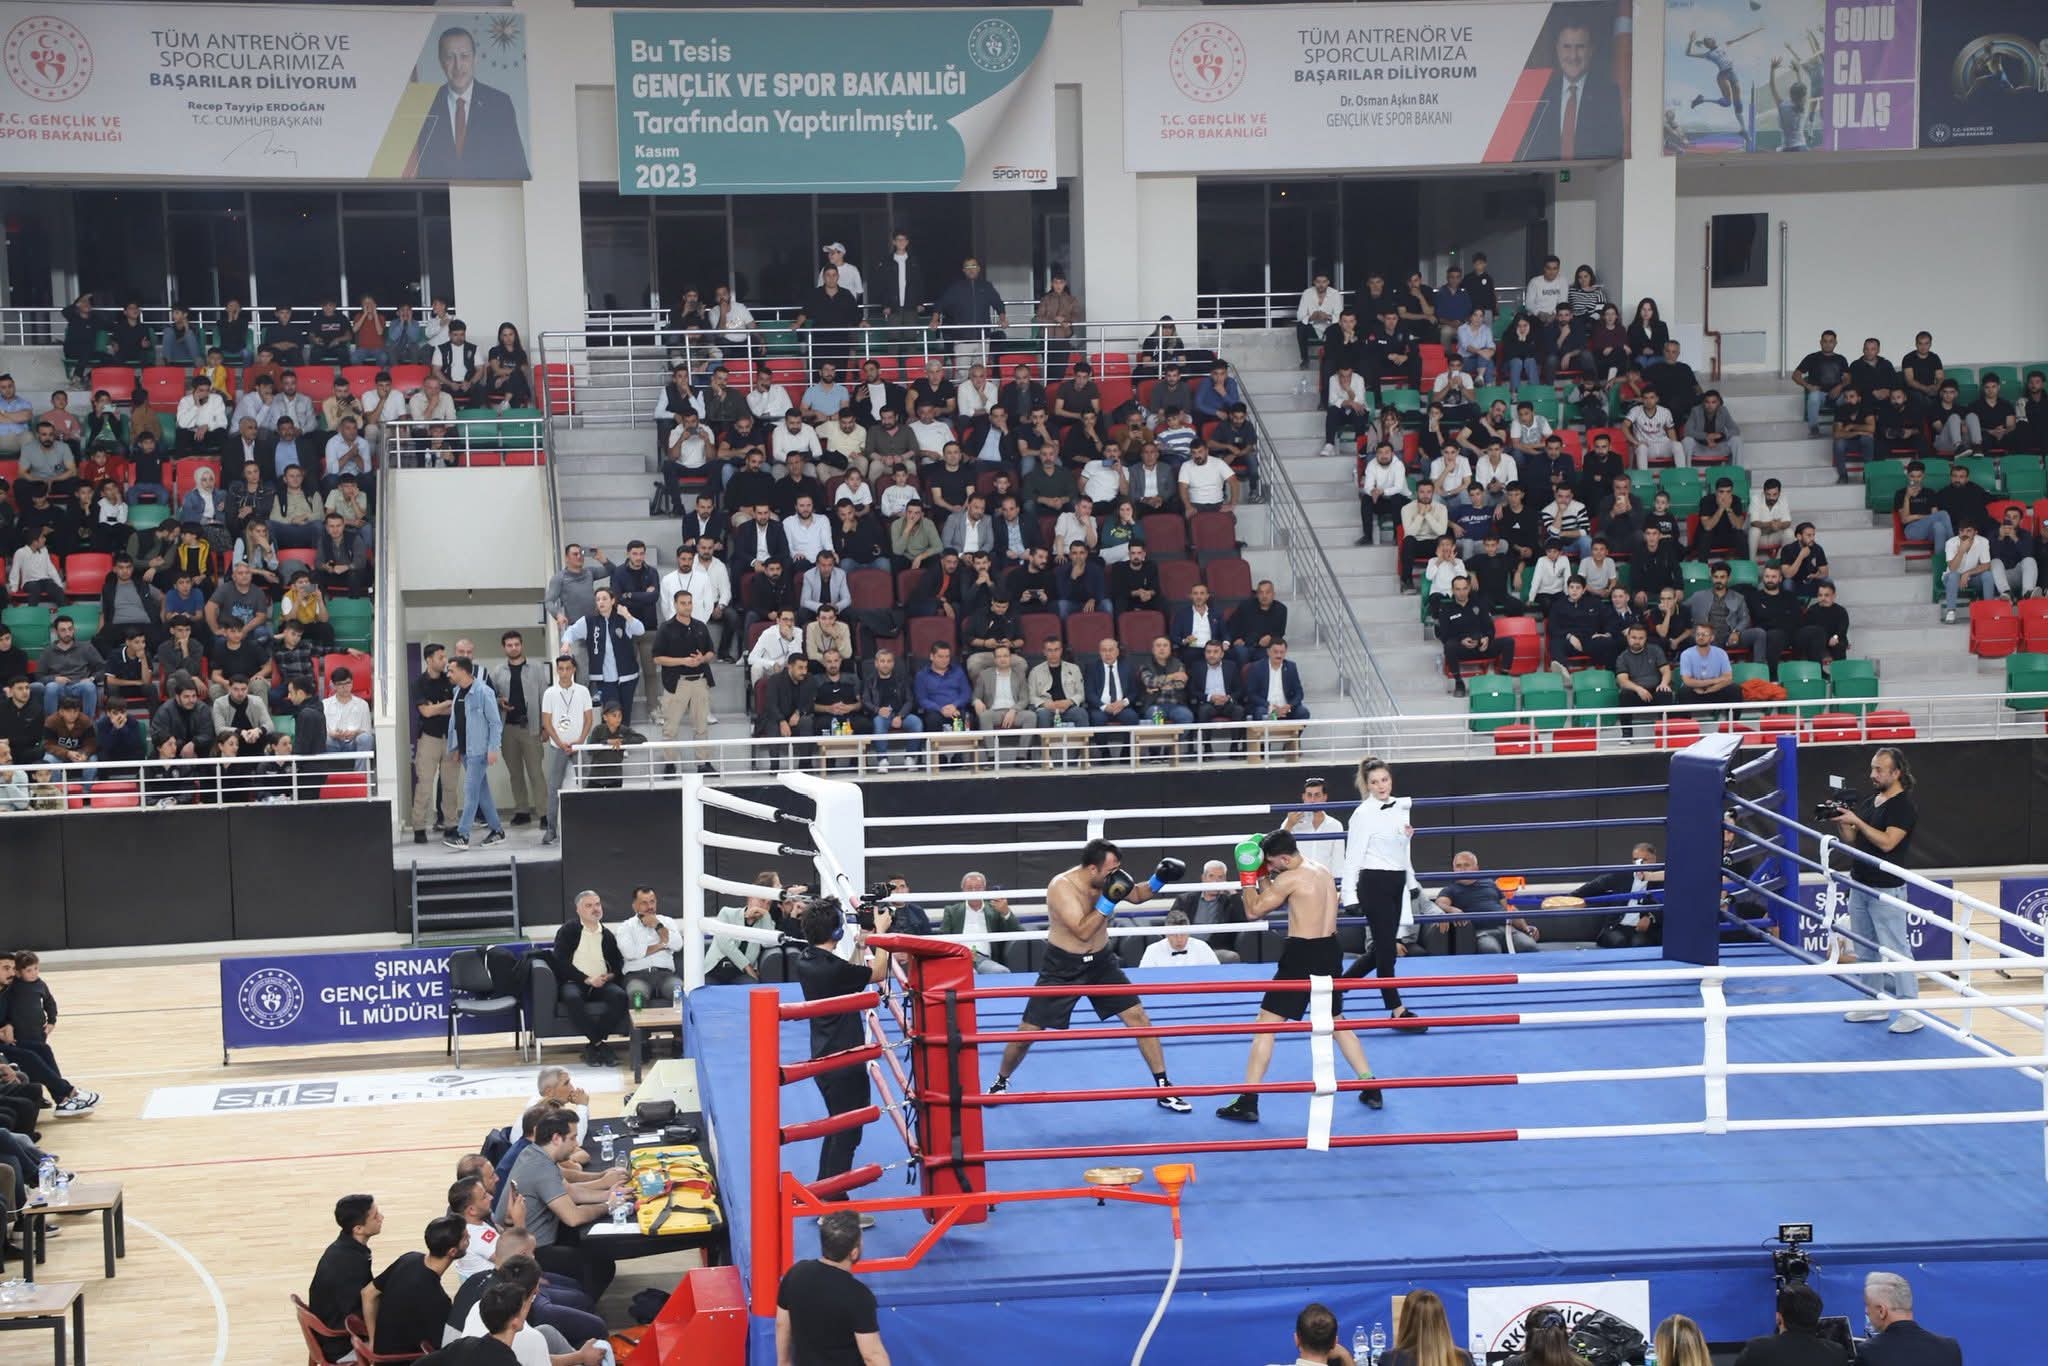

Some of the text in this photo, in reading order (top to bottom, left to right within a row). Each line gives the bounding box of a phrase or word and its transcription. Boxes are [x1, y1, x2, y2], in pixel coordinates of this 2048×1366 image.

[151, 29, 350, 51] TÜM ANTRENÖR VE
[1298, 25, 1473, 45] TÜM ANTRENÖR VE
[631, 38, 732, 63] Bu Tesis
[1304, 45, 1468, 64] SPORCULARIMIZA
[159, 51, 345, 71] SPORCULARIMIZA
[1833, 49, 1863, 85] CA
[150, 72, 357, 90] BAŞARILAR DİLİYORUM
[737, 72, 768, 98] VE
[773, 72, 837, 97] SPOR
[842, 64, 967, 97] BAKANLIĞI
[1294, 65, 1477, 85] BAŞARILAR DİLİYORUM
[187, 101, 325, 113] Recep Tayyip ERDOĞAN
[1340, 93, 1439, 107] Dr. Osman Aşkın BAK
[29, 113, 97, 129] GENÇLİK
[101, 116, 121, 127] VE
[192, 114, 323, 128] T.C. CUMHURBAŞKANI
[1160, 112, 1268, 127] T.C. GENÇLİK VE
[1326, 111, 1453, 129] GENÇLİK VE SPOR BAKANI
[1832, 91, 1891, 131] ULAŞ
[633, 108, 939, 140] Tarafından Yaptırılmıştır.
[1160, 126, 1267, 139] SPOR BAKANLIĞI
[0, 128, 122, 142] SPOR BAKANLIĞI
[634, 145, 680, 158] Kasım
[635, 163, 697, 189] 2023
[374, 958, 450, 982] ŞIRNAK
[320, 980, 412, 1005] GENÇLİK
[416, 981, 444, 998] VE
[339, 1002, 456, 1026] İL MÜDÜRL
